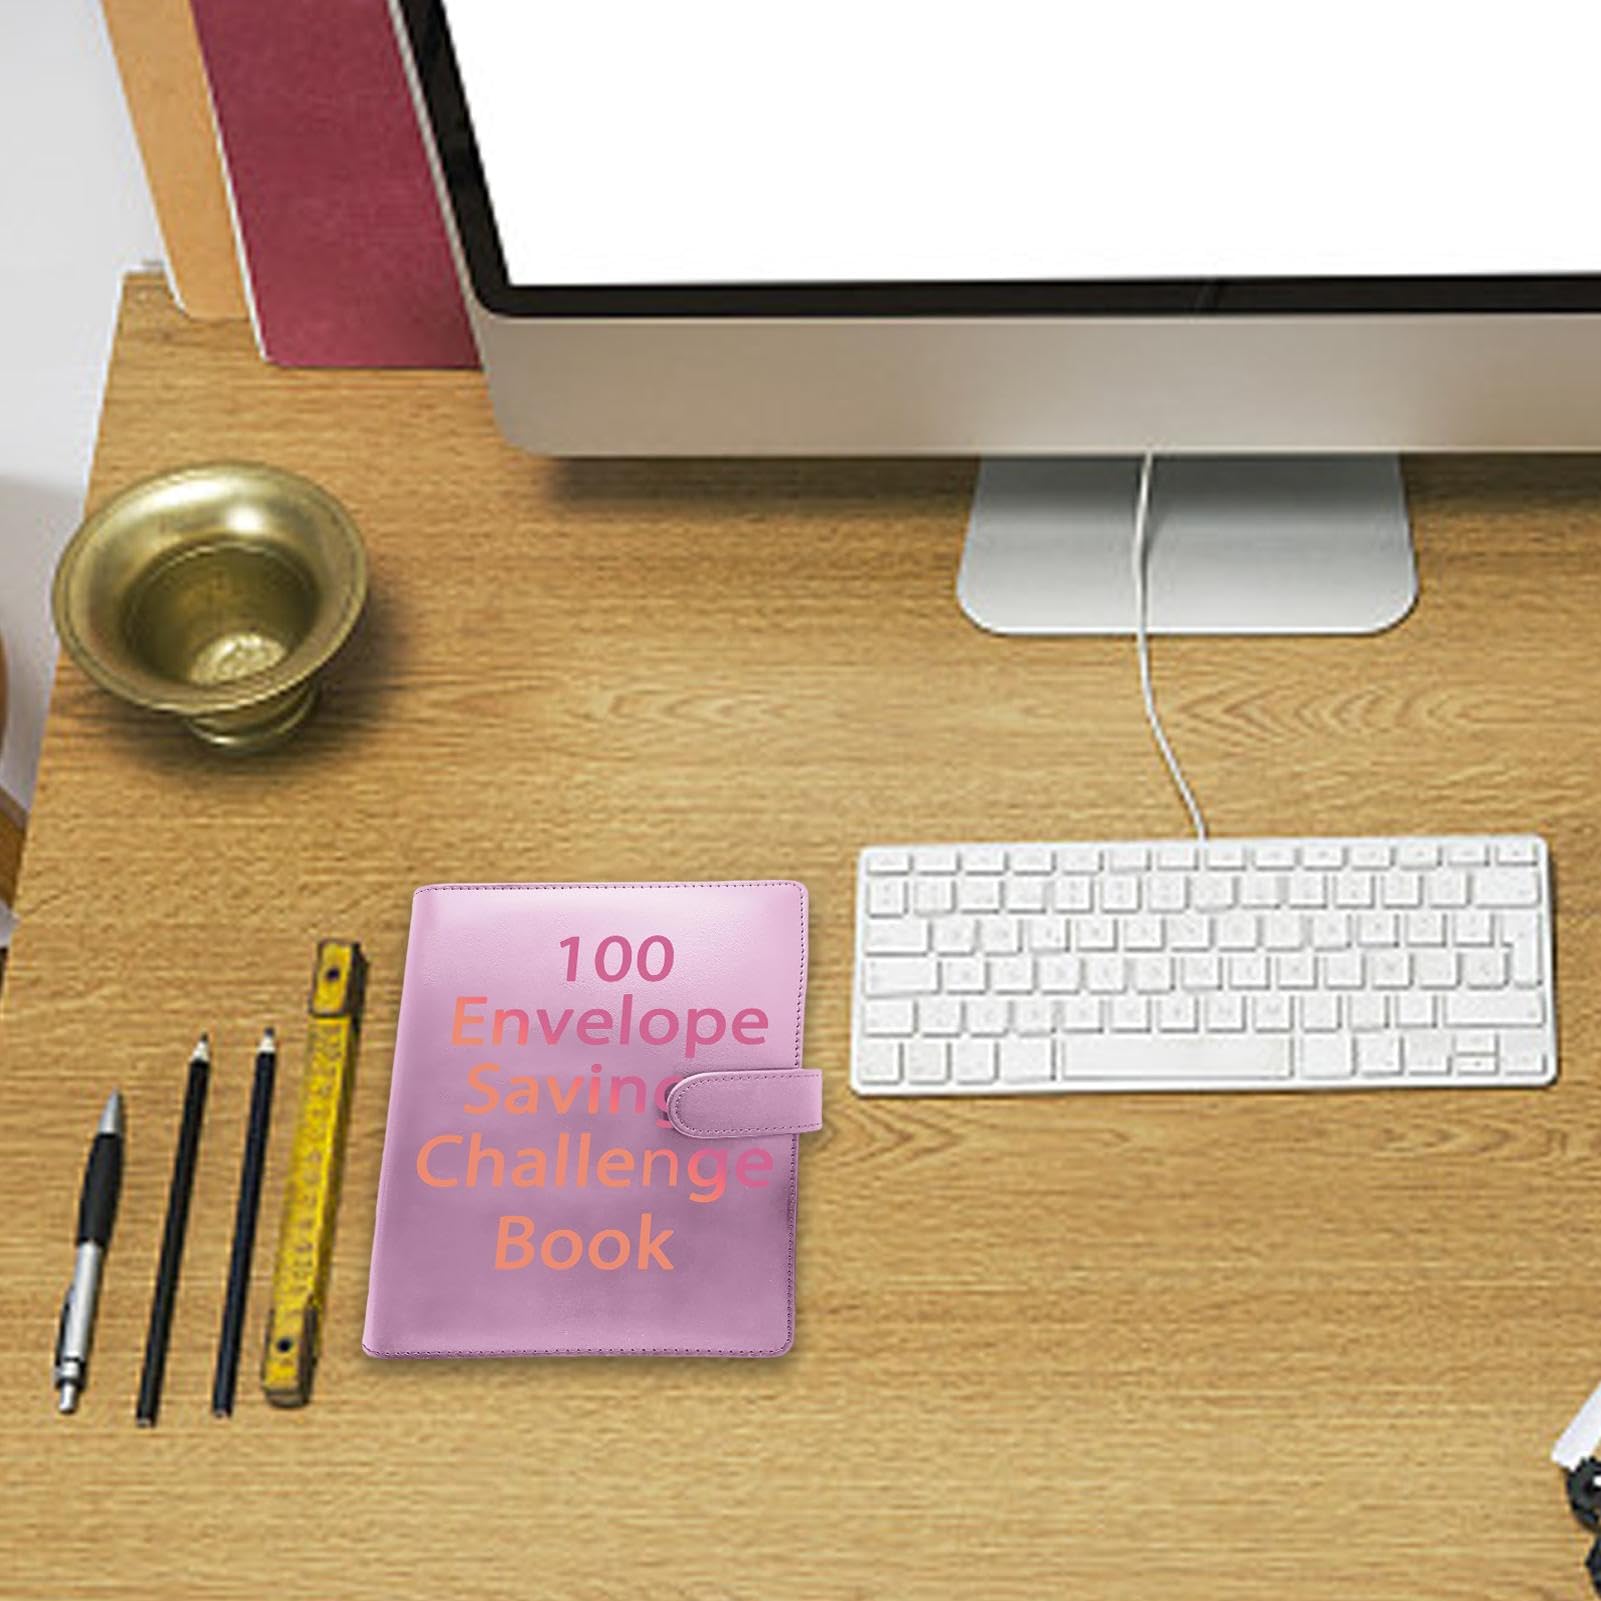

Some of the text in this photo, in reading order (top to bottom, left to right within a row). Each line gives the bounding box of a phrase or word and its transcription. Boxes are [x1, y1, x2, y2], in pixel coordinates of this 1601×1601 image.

[559, 934, 675, 982] 100
[451, 993, 769, 1058] Envelope
[416, 1132, 774, 1203] Challenge
[494, 1213, 674, 1270] Book
